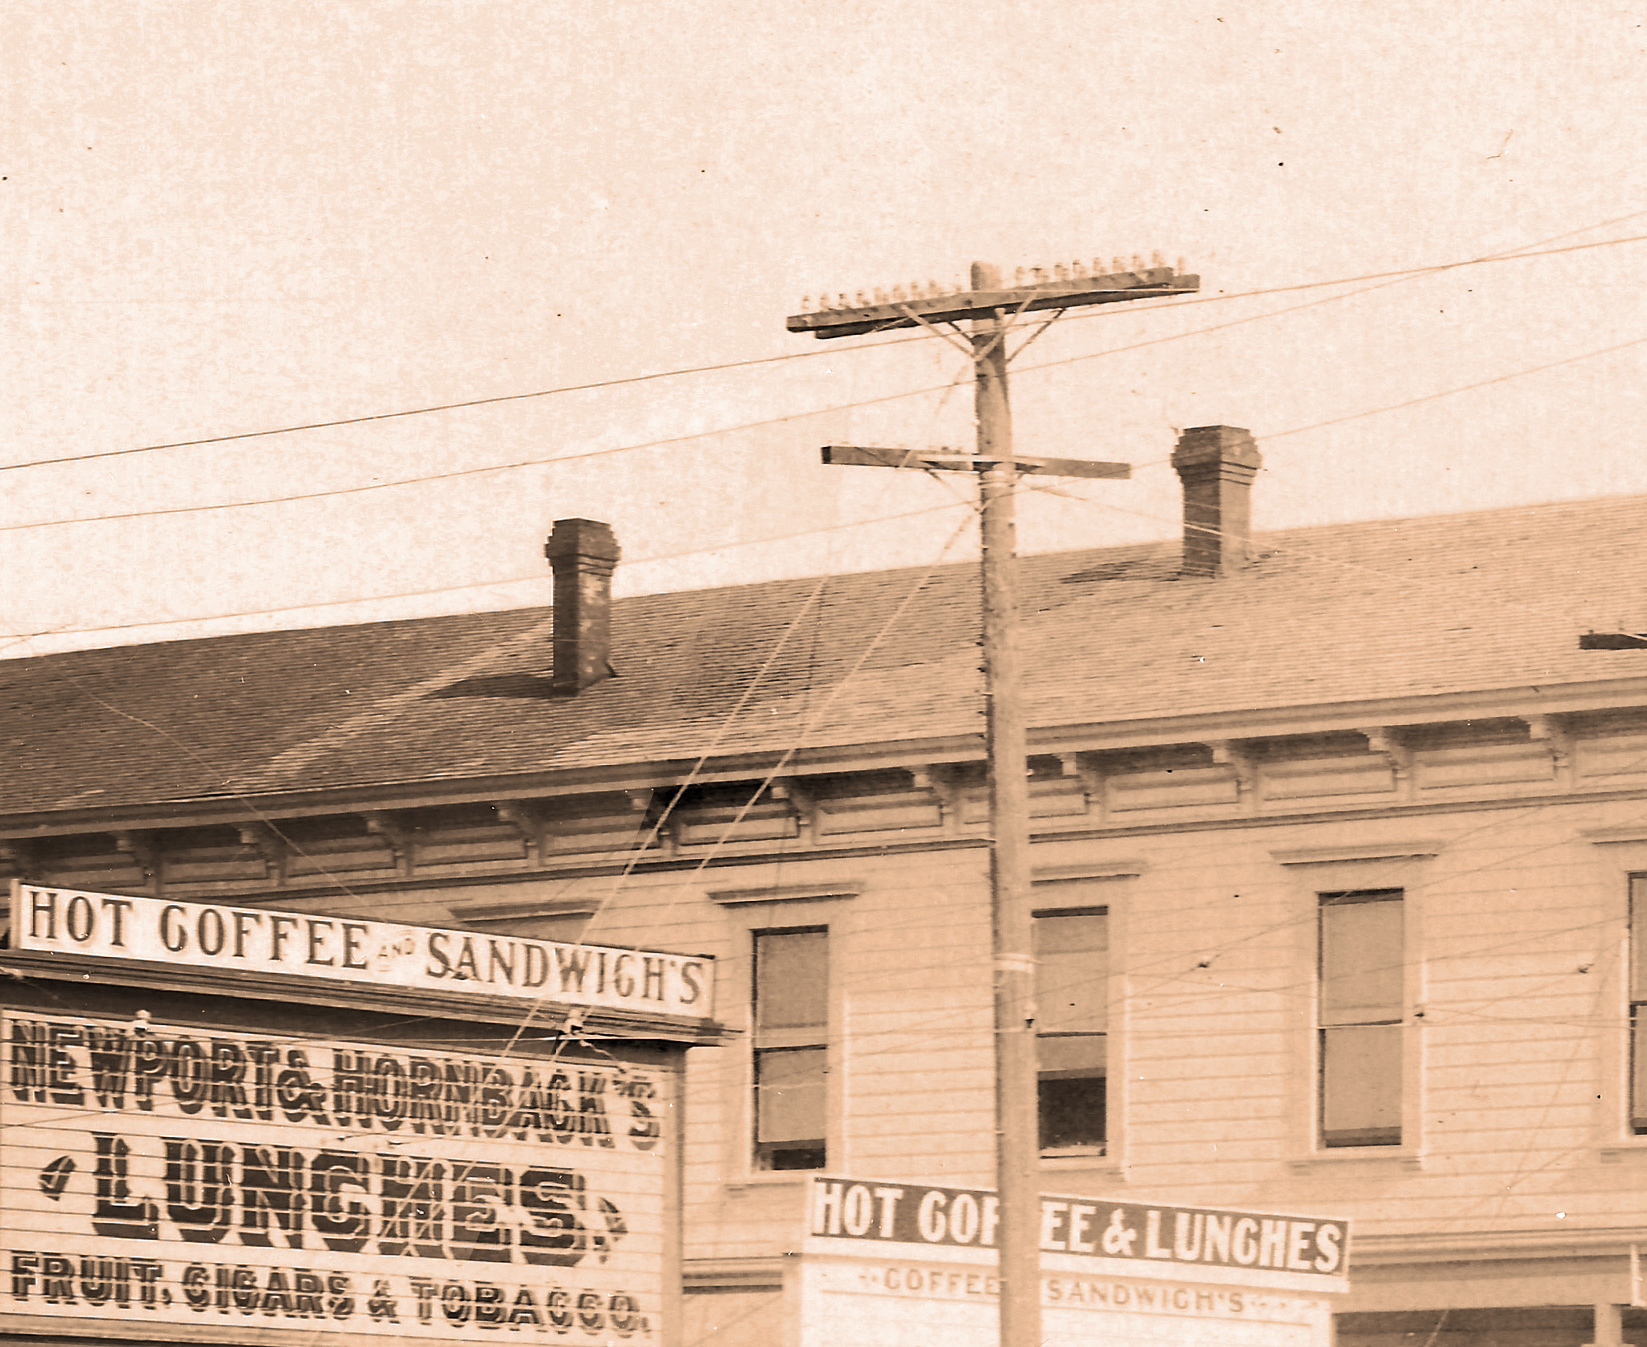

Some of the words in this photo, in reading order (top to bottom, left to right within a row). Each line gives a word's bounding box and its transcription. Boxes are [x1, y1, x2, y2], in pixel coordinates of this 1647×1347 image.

[28, 890, 132, 947] HOT
[159, 904, 368, 970] COFFEE
[426, 932, 703, 1005] SANDWICH'S
[11, 1020, 280, 1121] NEWPORT
[277, 1048, 331, 1126] &
[91, 1131, 589, 1267] LUNCHES
[813, 1182, 903, 1238] HOT
[918, 1190, 1096, 1253] COFEE
[1104, 1208, 1137, 1257] &
[1145, 1209, 1342, 1273] LUNCHES
[183, 1262, 354, 1320] CIGARS
[367, 1279, 400, 1325] &
[884, 1267, 1000, 1296] COFFEE
[1048, 1279, 1244, 1313] SANDWICH'S
